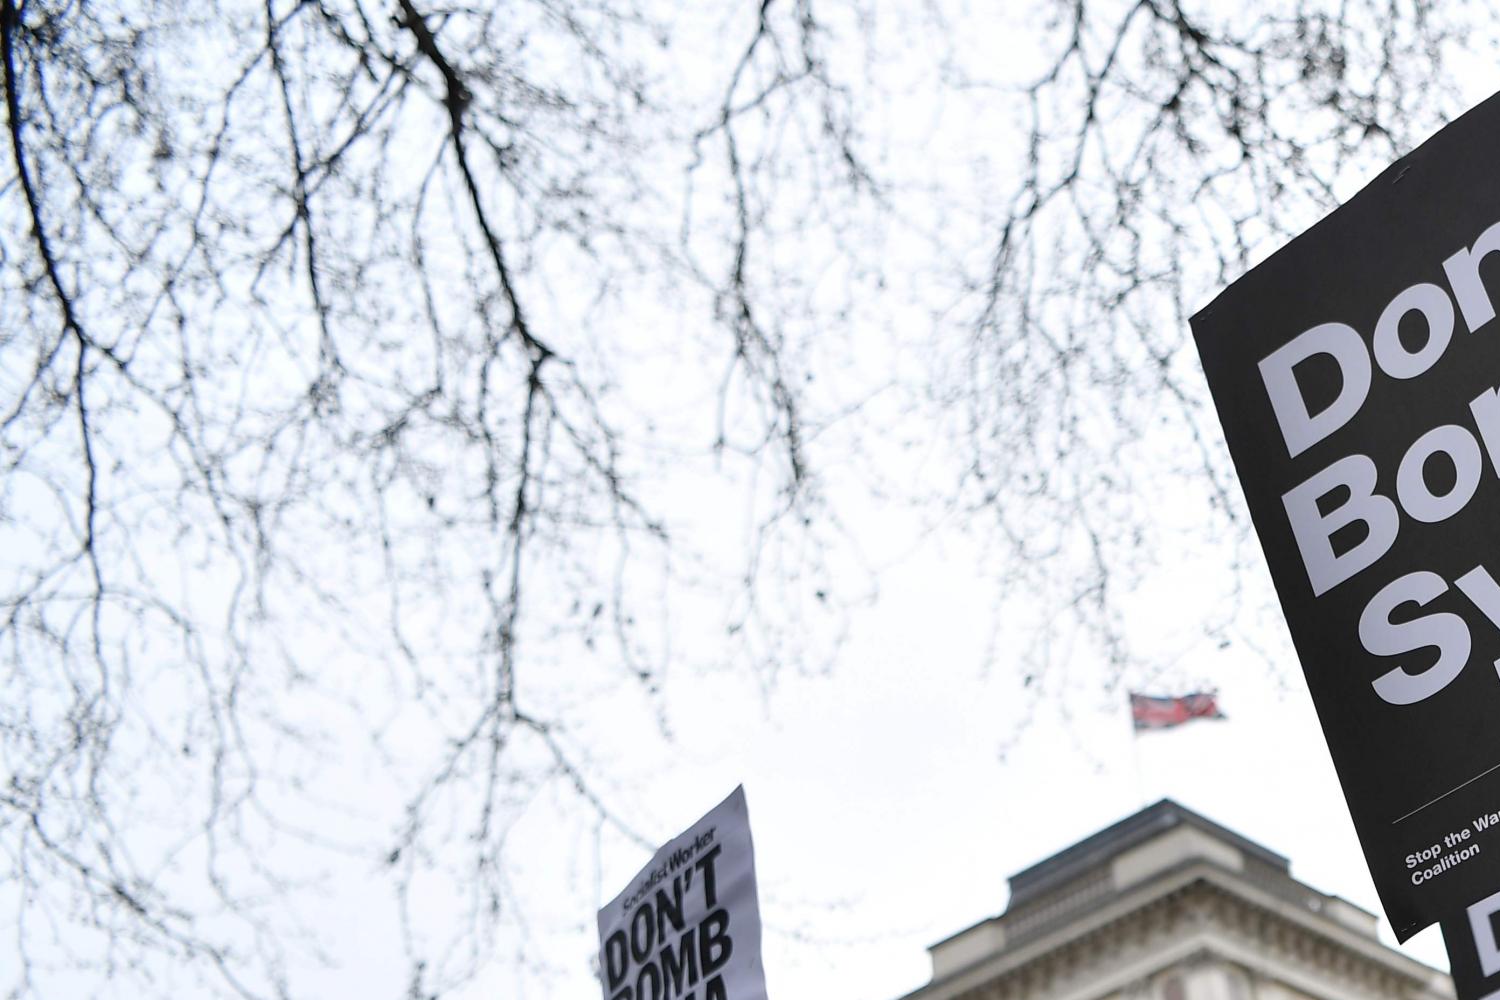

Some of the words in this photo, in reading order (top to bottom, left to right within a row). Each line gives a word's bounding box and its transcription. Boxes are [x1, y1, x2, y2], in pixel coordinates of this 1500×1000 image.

[1405, 844, 1442, 869] Stop
[1443, 828, 1471, 848] the
[1411, 843, 1480, 885] Coalition
[605, 841, 722, 993] DON'T
